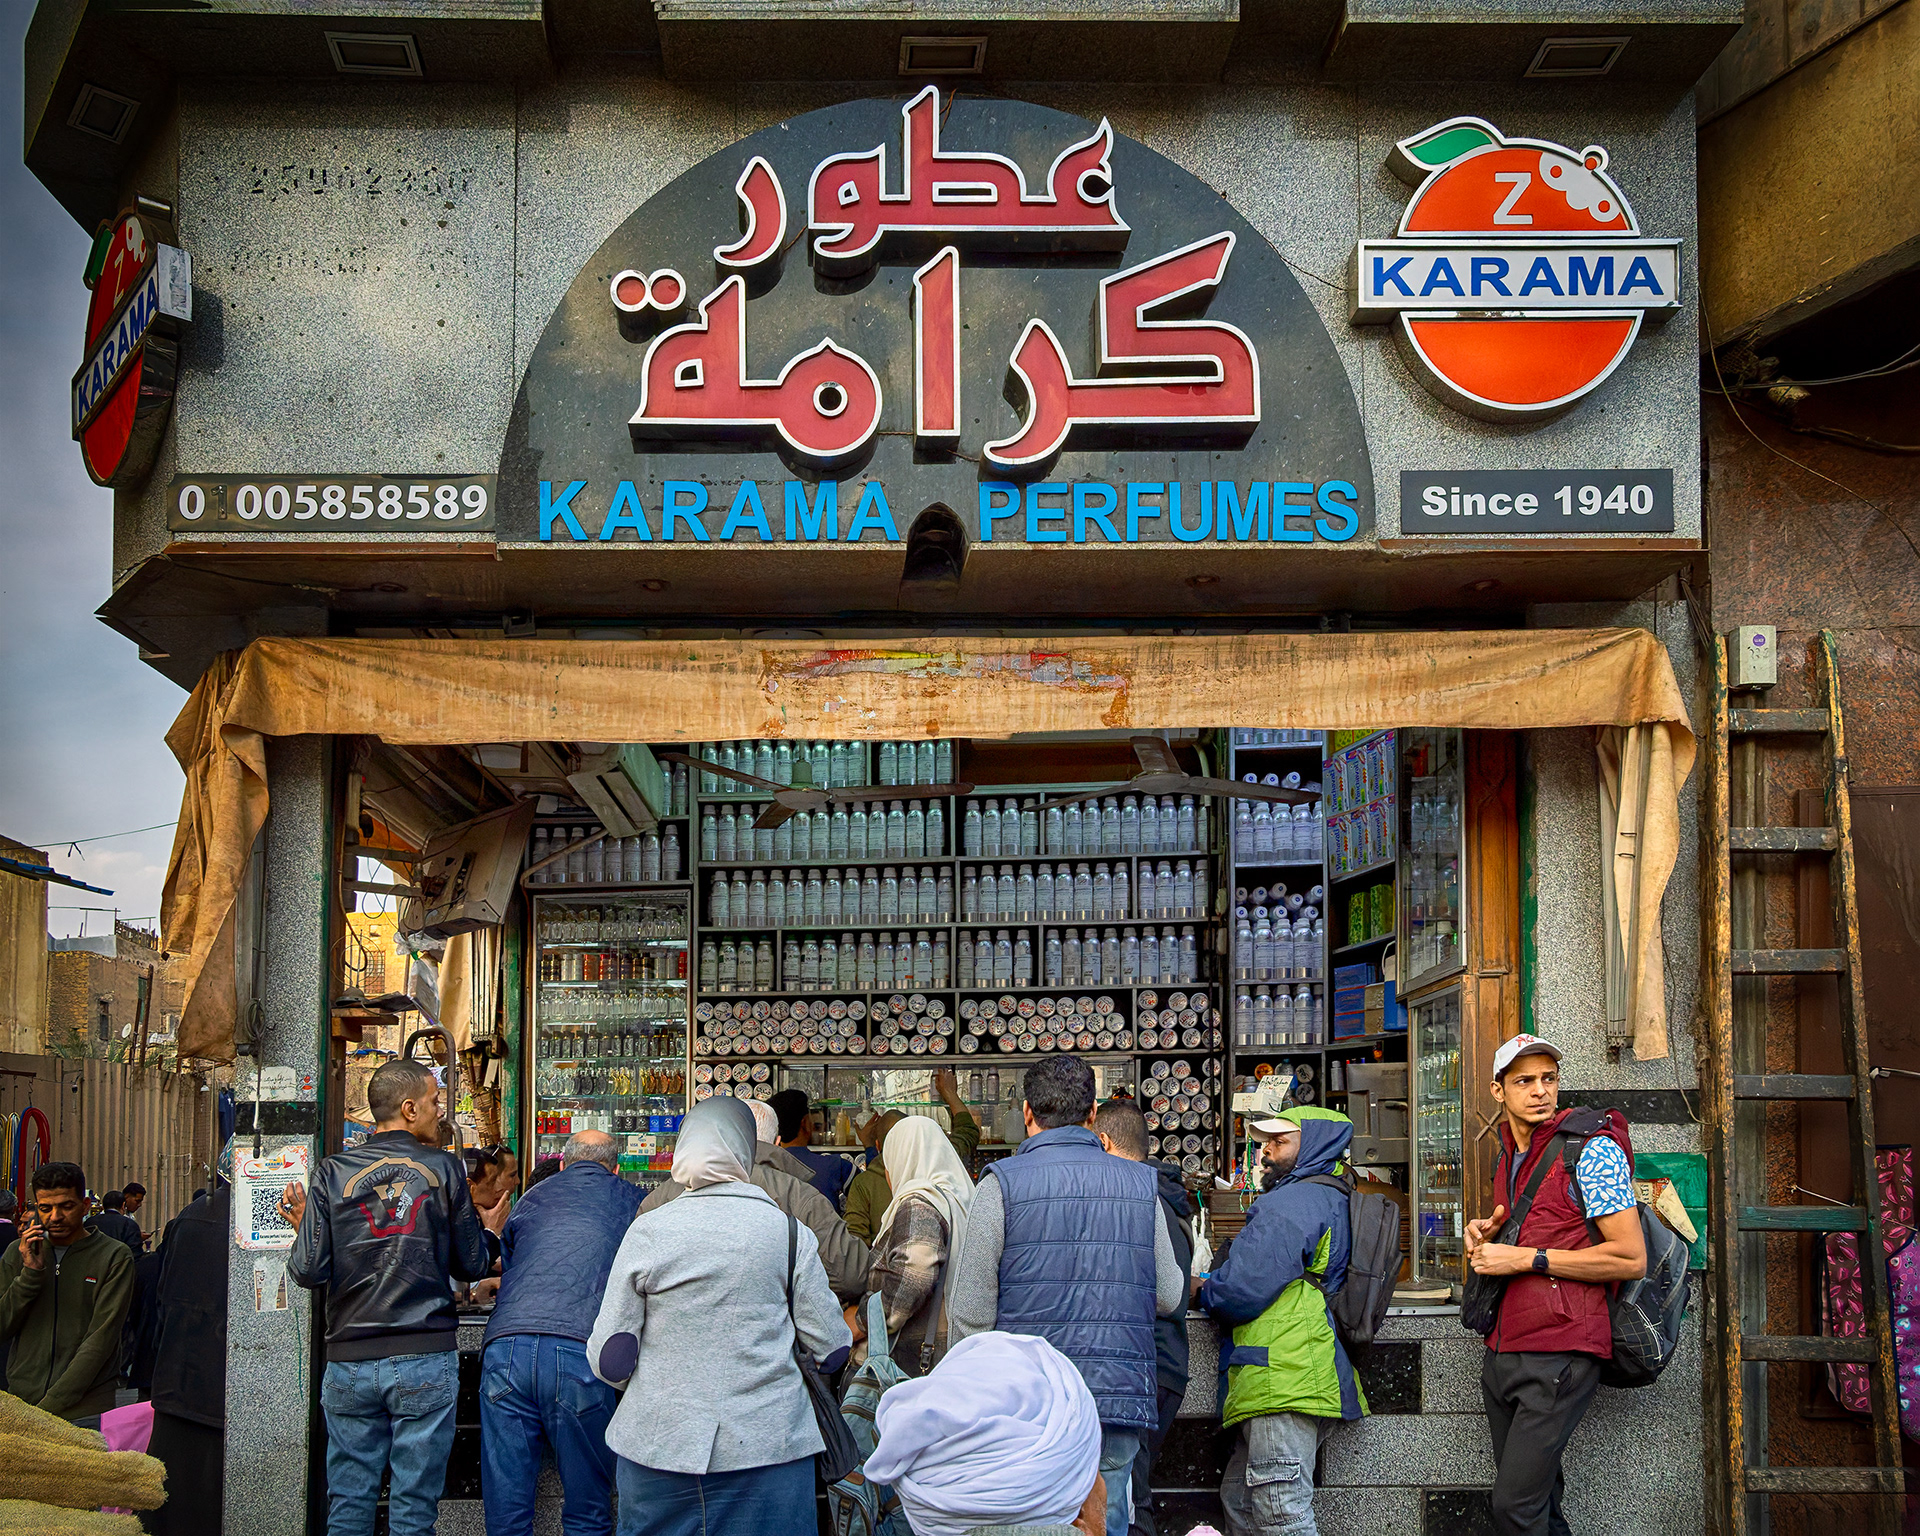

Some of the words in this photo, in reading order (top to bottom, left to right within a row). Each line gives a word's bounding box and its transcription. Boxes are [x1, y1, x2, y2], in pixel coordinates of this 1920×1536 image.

[713, 85, 1131, 267] عطور
[1493, 172, 1533, 225] Z
[113, 248, 125, 310] Z
[1372, 256, 1665, 297] KARAMA
[78, 276, 159, 422] KARAMA
[610, 231, 1261, 466] كرامة
[539, 480, 900, 542] KARAMA
[978, 479, 1359, 543] PERFUMES
[1421, 485, 1539, 516] Since
[1554, 484, 1655, 516] 1940
